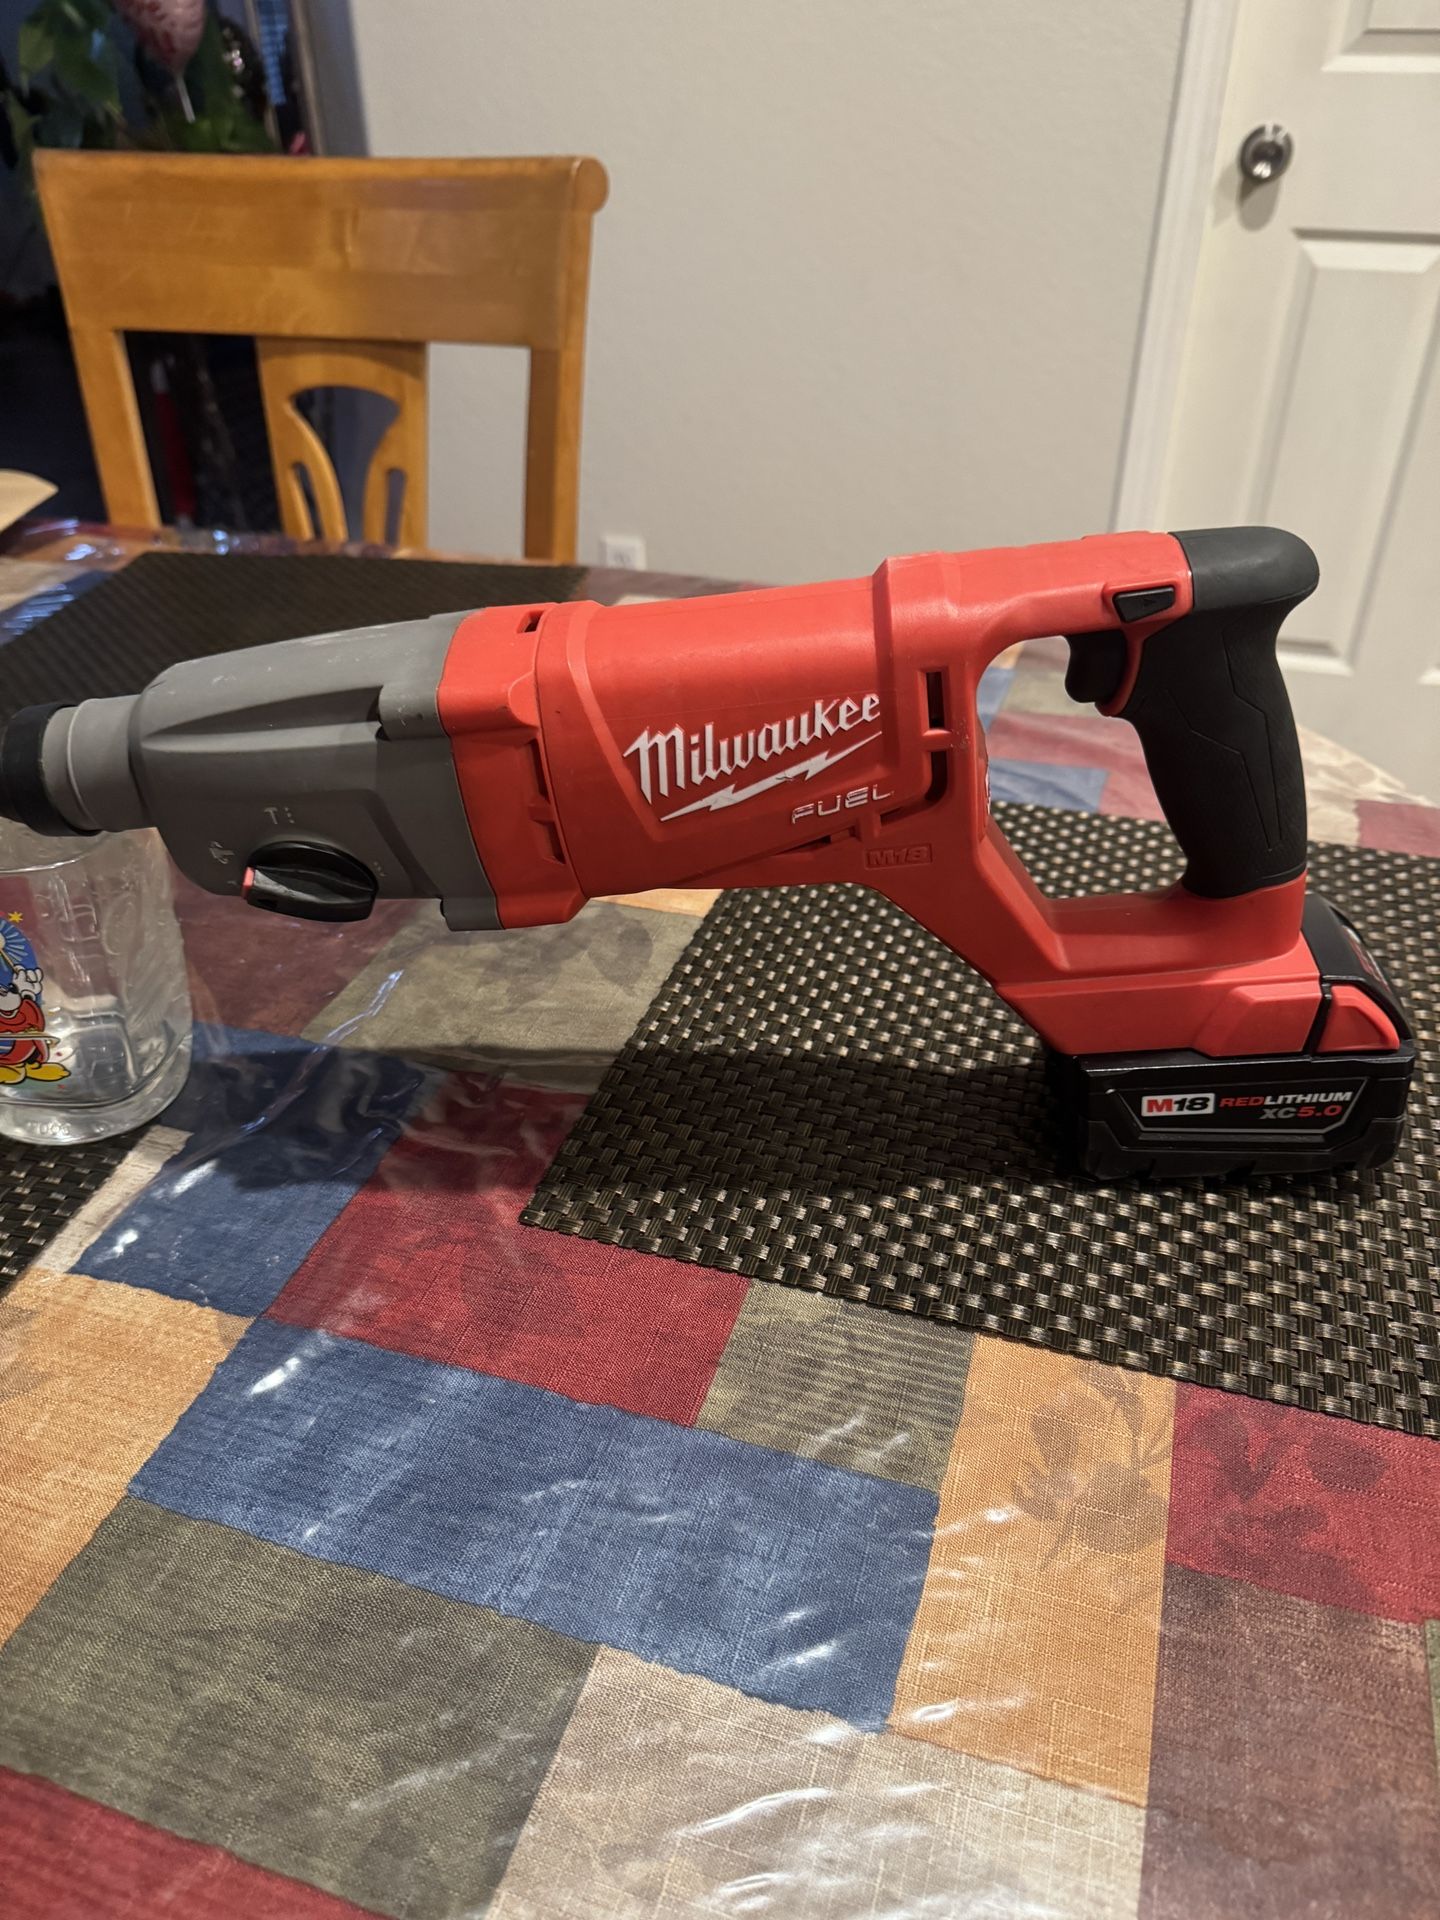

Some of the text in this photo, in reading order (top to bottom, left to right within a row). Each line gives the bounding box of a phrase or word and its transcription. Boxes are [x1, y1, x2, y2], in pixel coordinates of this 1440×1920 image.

[622, 693, 881, 804] Milwaukee
[791, 784, 891, 824] FUEL
[869, 846, 929, 865] M18
[1145, 1091, 1353, 1113] M18 REDLITHIUM
[1259, 1104, 1342, 1120] XC5.0
